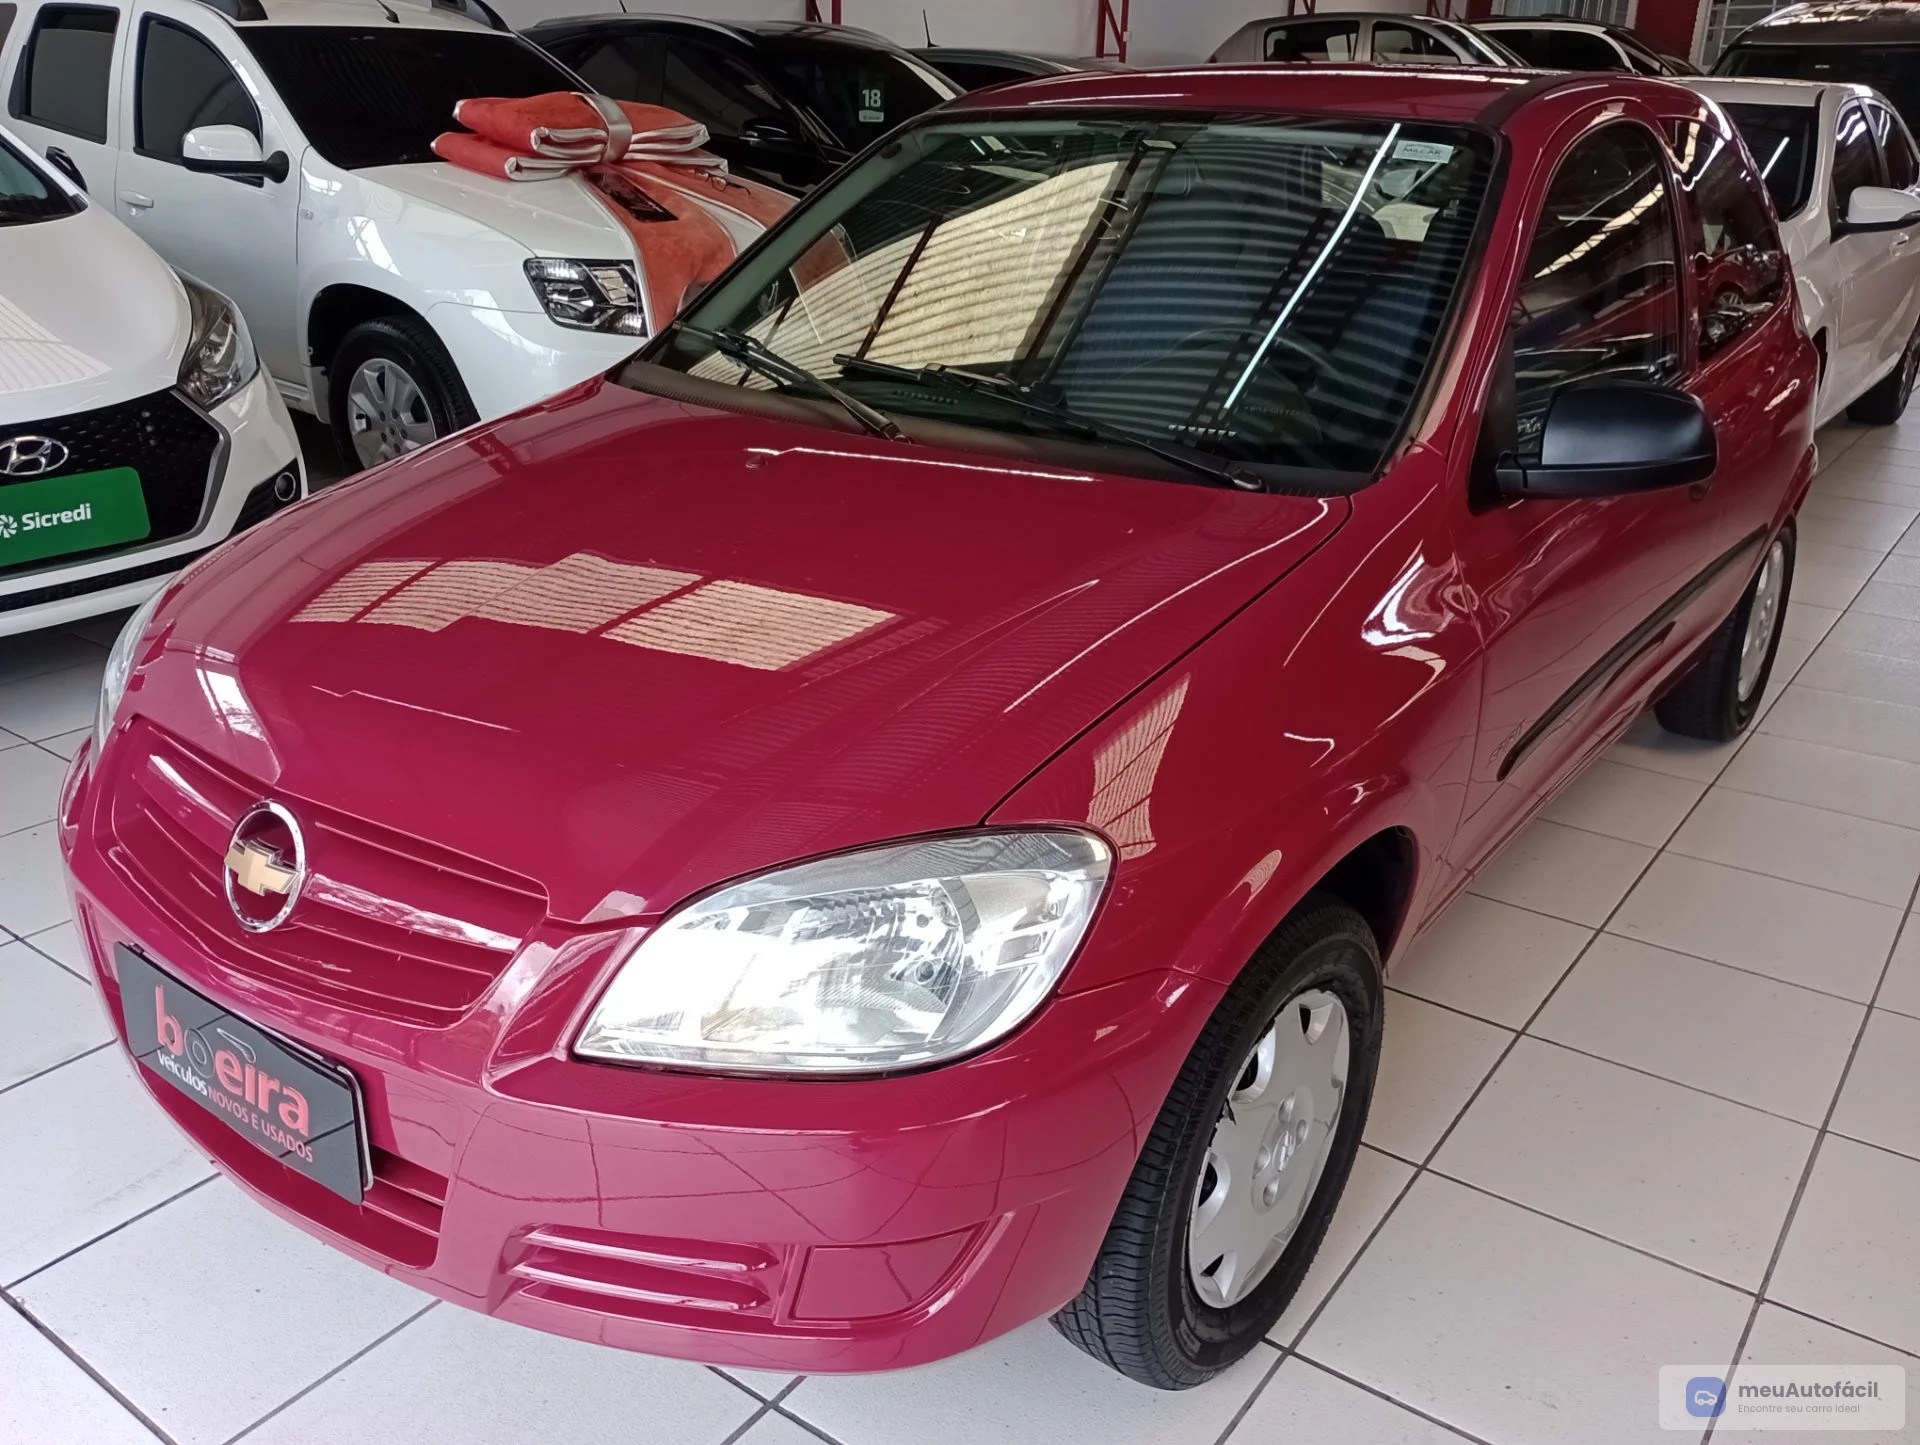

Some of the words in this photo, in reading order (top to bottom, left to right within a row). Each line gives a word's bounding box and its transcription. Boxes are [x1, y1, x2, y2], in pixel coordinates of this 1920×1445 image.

[862, 89, 881, 107] 18
[22, 503, 92, 531] Sicredi
[155, 984, 309, 1137] boeira
[207, 1086, 249, 1124] NOVOS
[251, 1112, 260, 1130] E
[261, 1120, 314, 1163] USADOS
